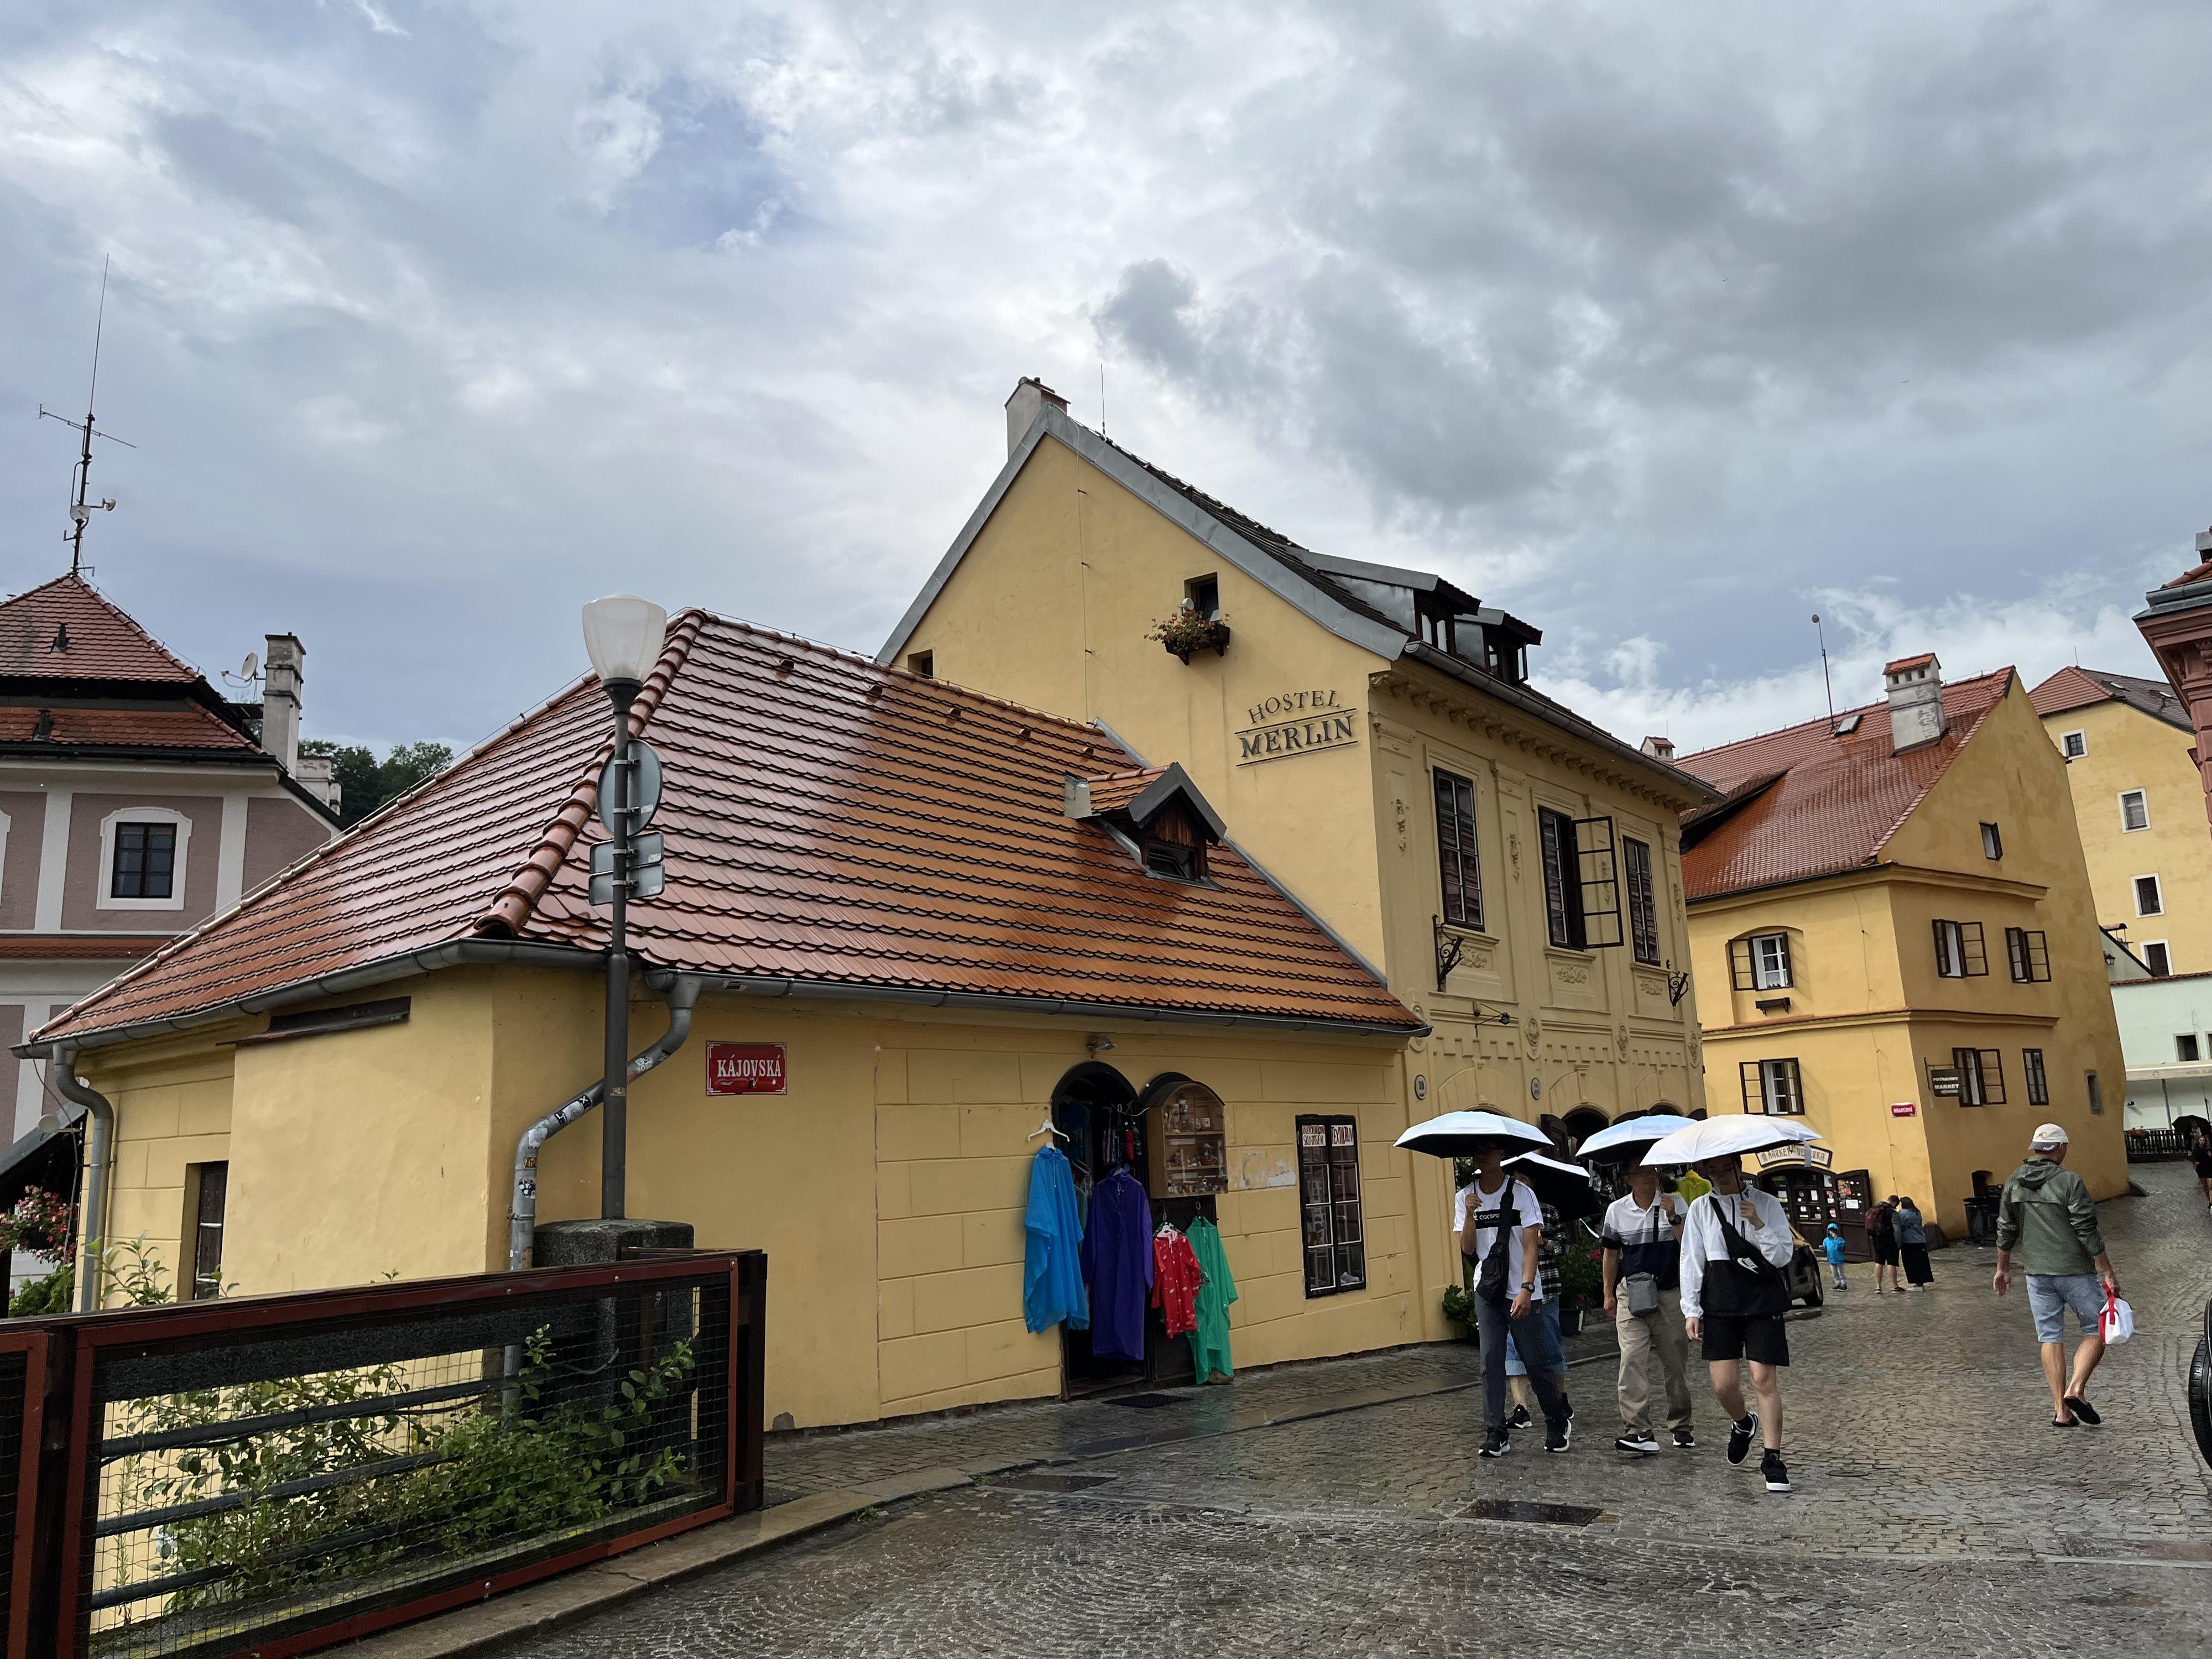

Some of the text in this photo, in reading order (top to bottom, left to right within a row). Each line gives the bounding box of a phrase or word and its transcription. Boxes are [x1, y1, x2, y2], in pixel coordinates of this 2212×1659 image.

[1247, 690, 1340, 725] HOSTEL
[1239, 714, 1354, 758] MERLIN
[717, 1054, 782, 1077] KÁJOVSKÁ
[1768, 1147, 1825, 1161] MARKET VERKA
